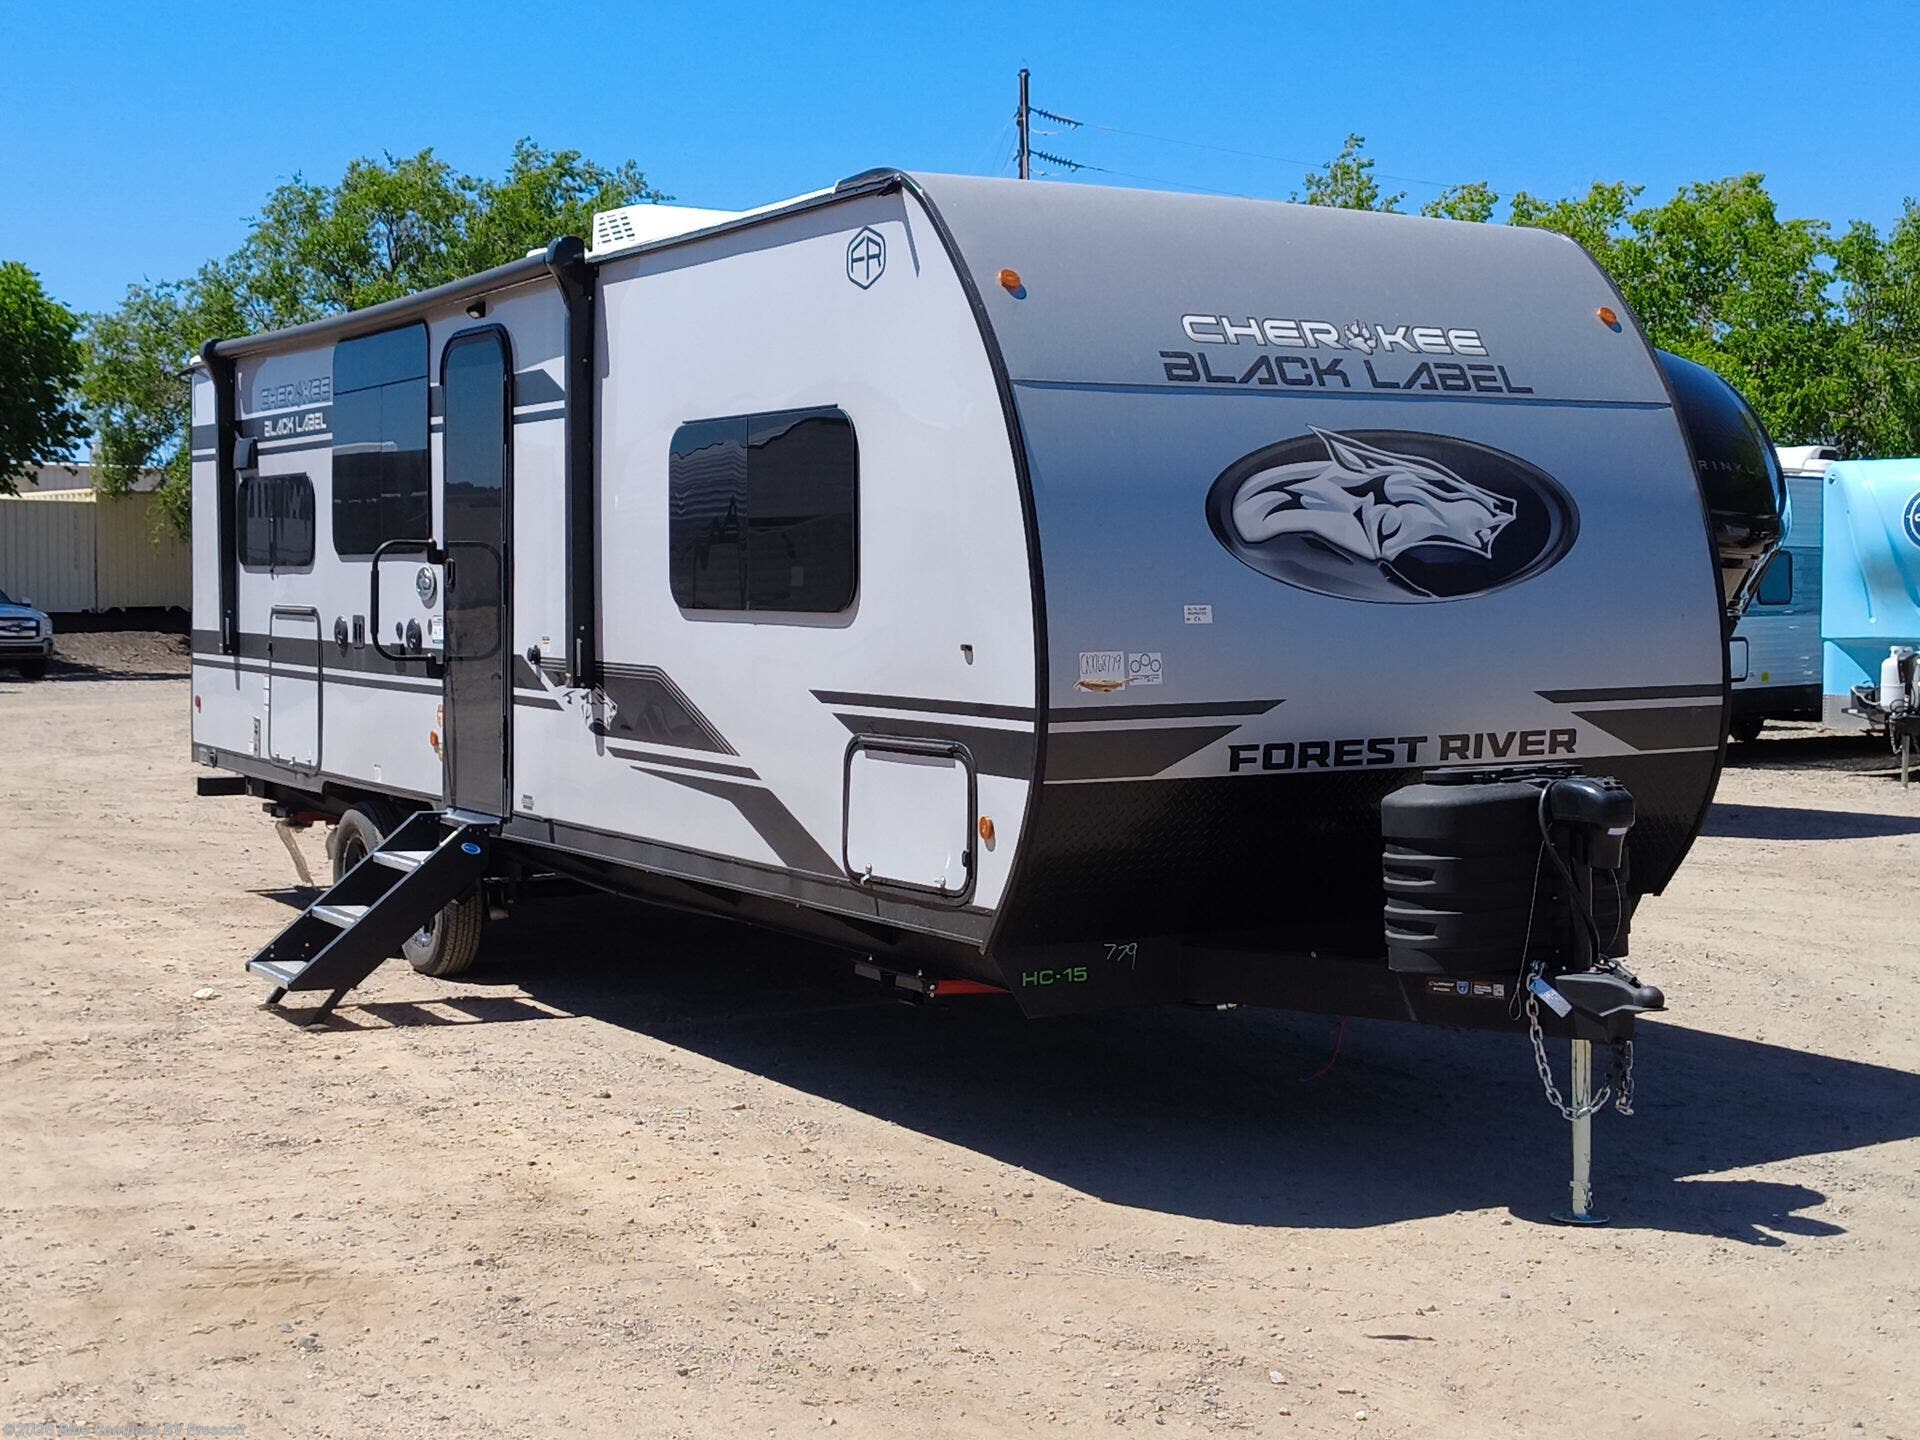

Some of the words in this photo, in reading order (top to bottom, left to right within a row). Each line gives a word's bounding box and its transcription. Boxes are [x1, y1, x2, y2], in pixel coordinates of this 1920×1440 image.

[1181, 313, 1489, 357] CHEROKEE
[1159, 350, 1350, 387] BLACK
[1363, 359, 1534, 394] LABEL
[264, 416, 294, 437] BLACK
[296, 412, 326, 432] LABEL
[1228, 736, 1428, 772] FOREST
[1438, 728, 1577, 761] RIVER
[1103, 942, 1137, 970] 779
